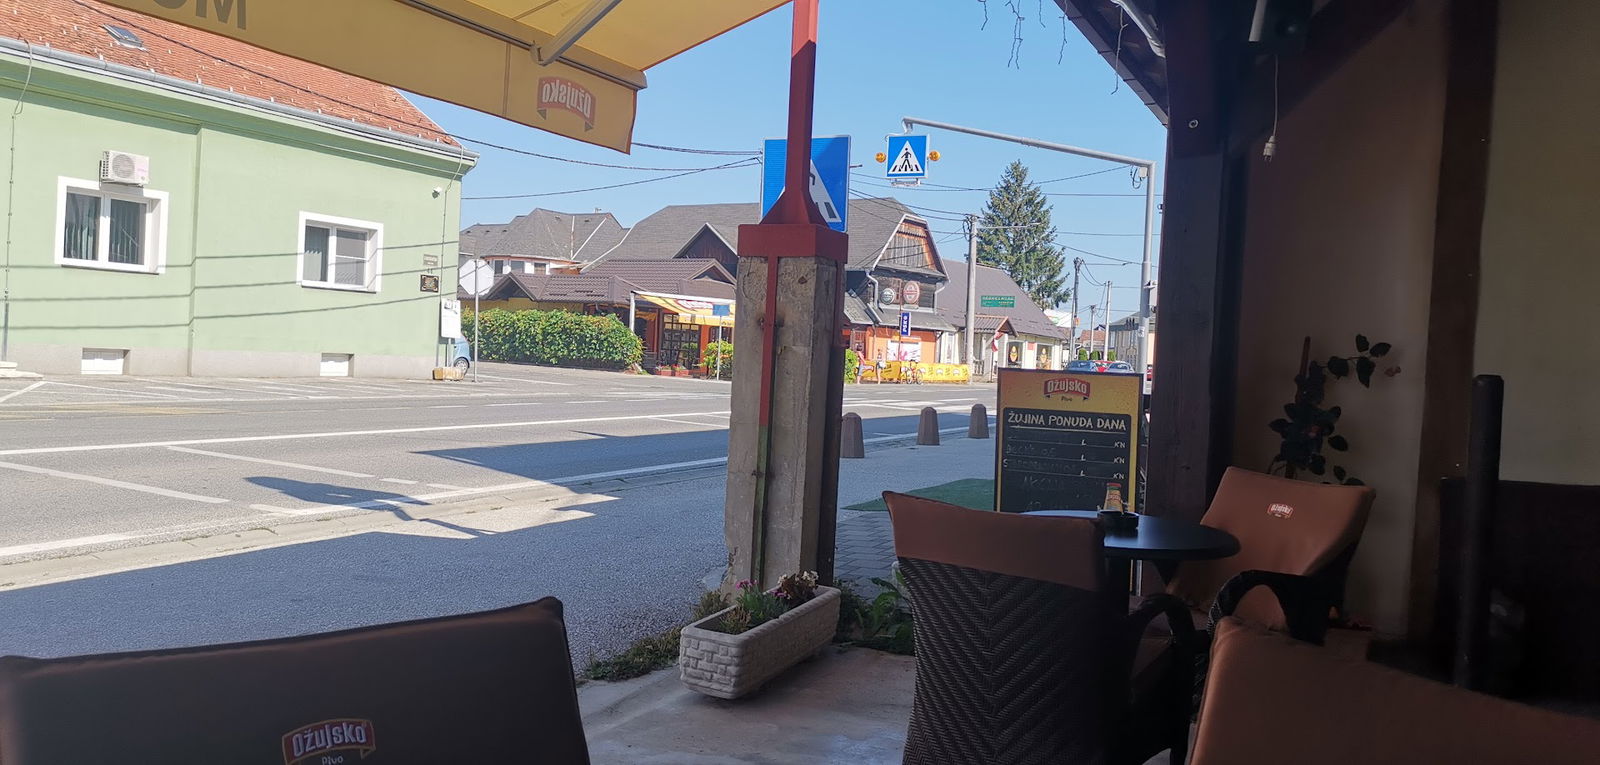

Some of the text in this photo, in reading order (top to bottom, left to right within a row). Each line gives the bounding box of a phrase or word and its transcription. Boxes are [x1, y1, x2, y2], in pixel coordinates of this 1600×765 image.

[1047, 378, 1088, 394] Ožujsko
[1008, 411, 1127, 431] ŽUJINA PONUDA DANA
[292, 722, 367, 757] Ožujsko
